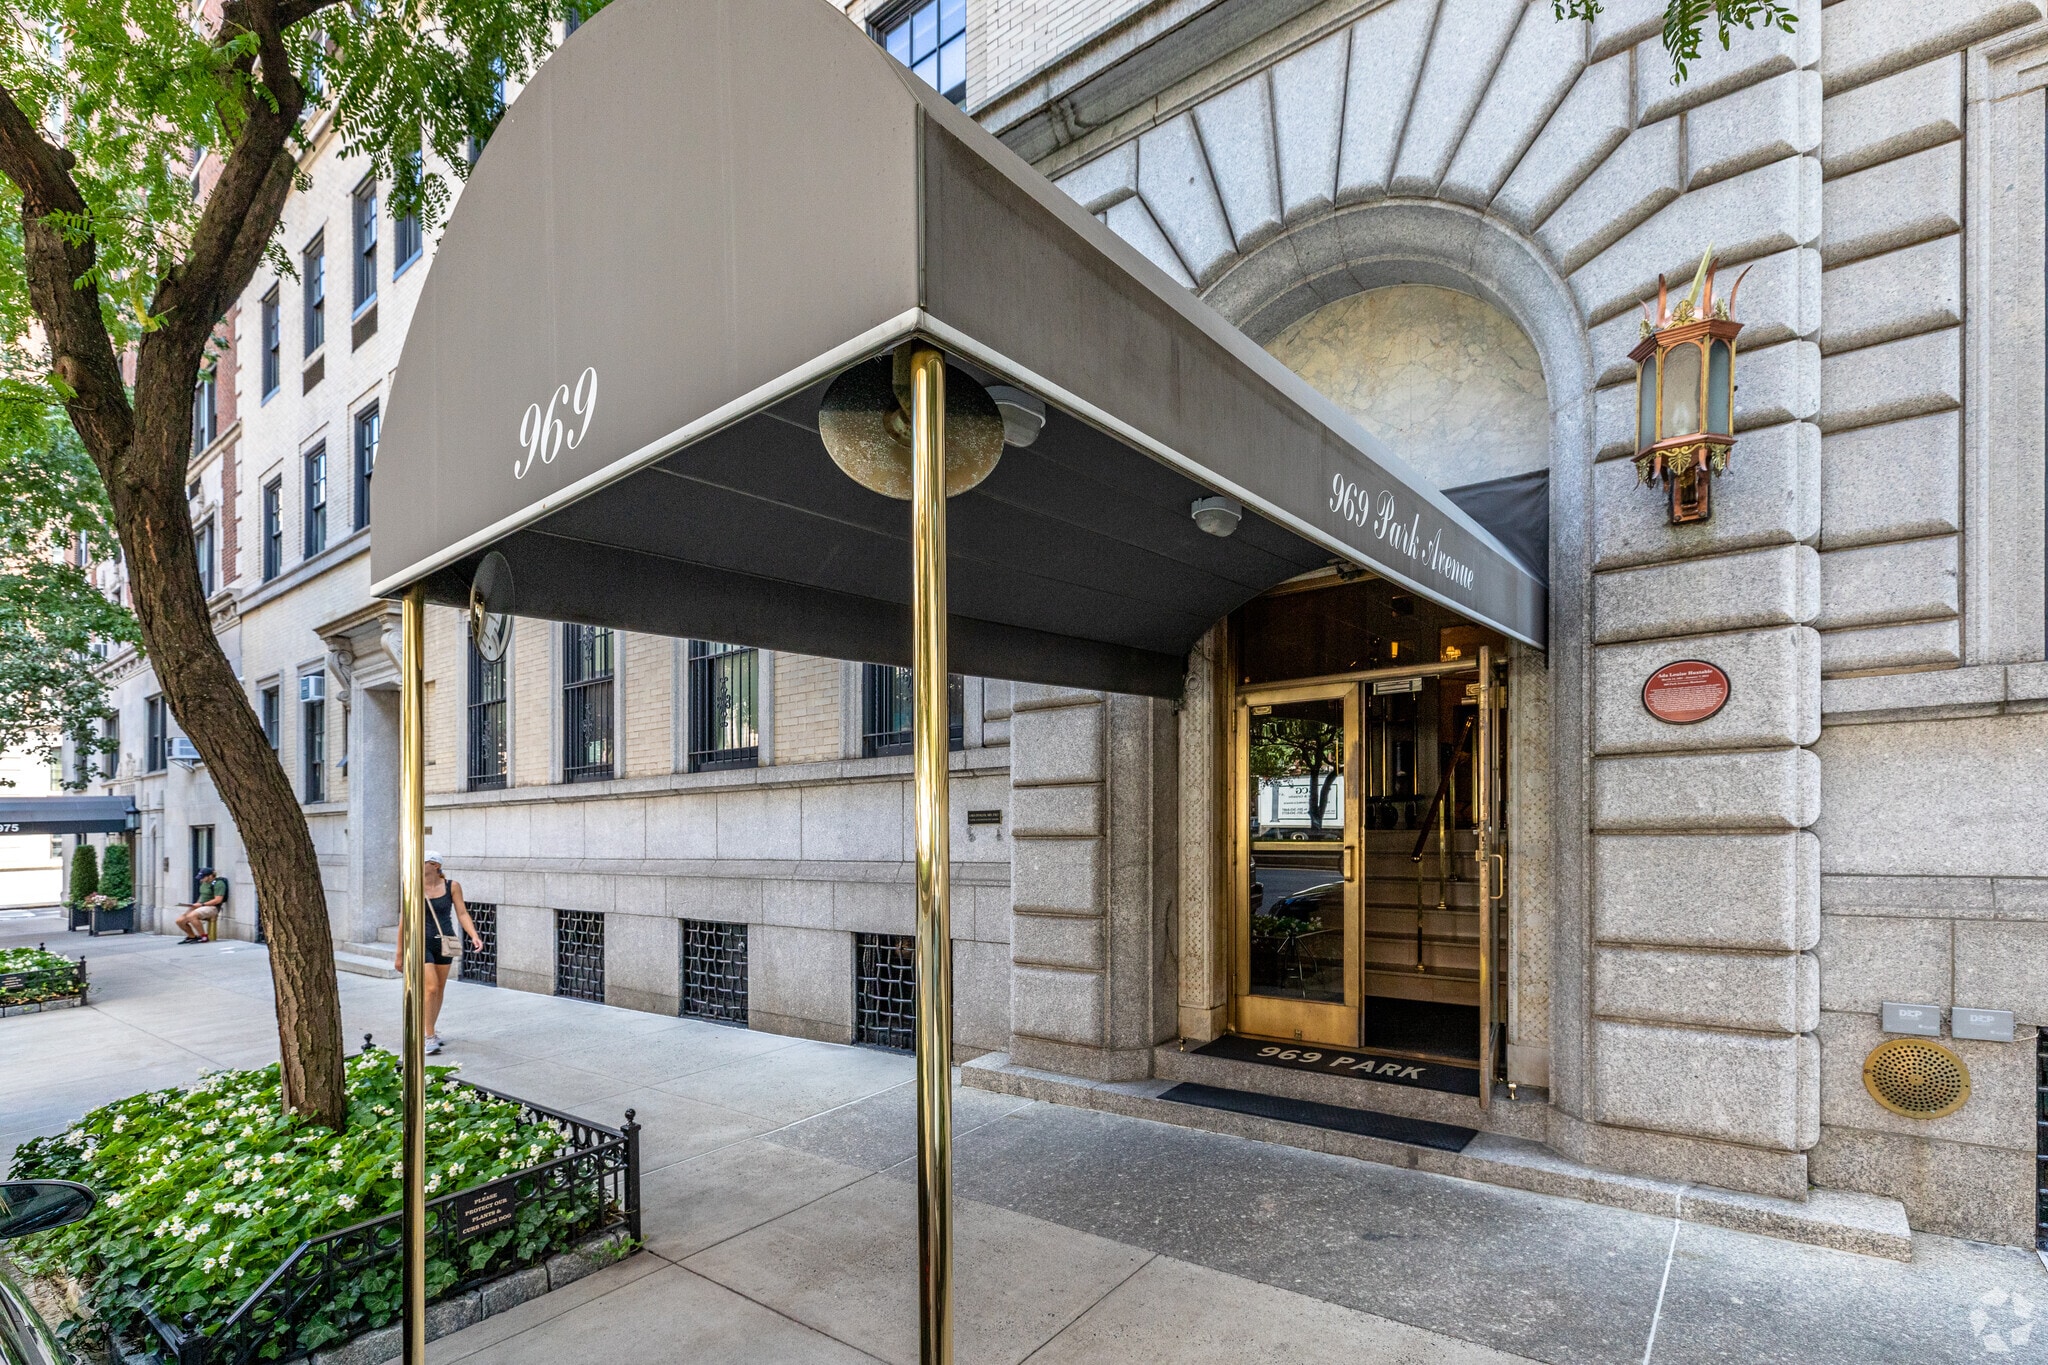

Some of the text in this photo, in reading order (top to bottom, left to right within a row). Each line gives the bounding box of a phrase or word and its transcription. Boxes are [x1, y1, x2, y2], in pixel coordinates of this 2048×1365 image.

[514, 366, 598, 480] 969
[1329, 473, 1475, 591] 969 Park Avenue
[1256, 1046, 1427, 1080] 969 PARK
[464, 1198, 508, 1217] PROTECT OUR
[474, 1192, 498, 1205] PLEASE
[462, 1213, 512, 1234] CURB YOUR DOG
[472, 1210, 496, 1222] PLANTS
